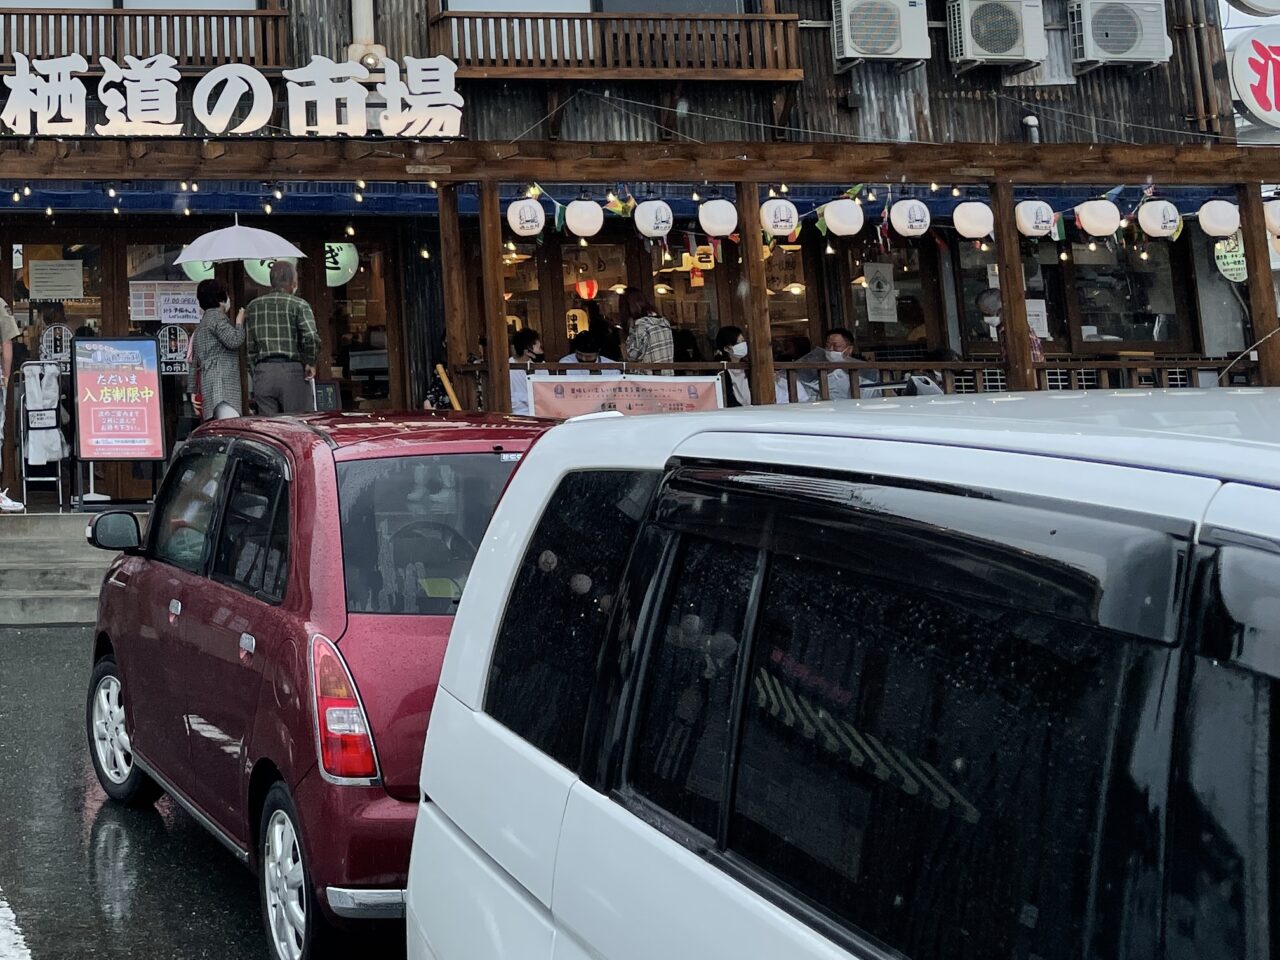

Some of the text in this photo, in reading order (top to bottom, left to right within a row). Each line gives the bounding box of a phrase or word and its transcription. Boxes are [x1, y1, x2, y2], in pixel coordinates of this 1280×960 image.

[97, 374, 137, 385] ただいま
[83, 386, 154, 403] 入店制限中
